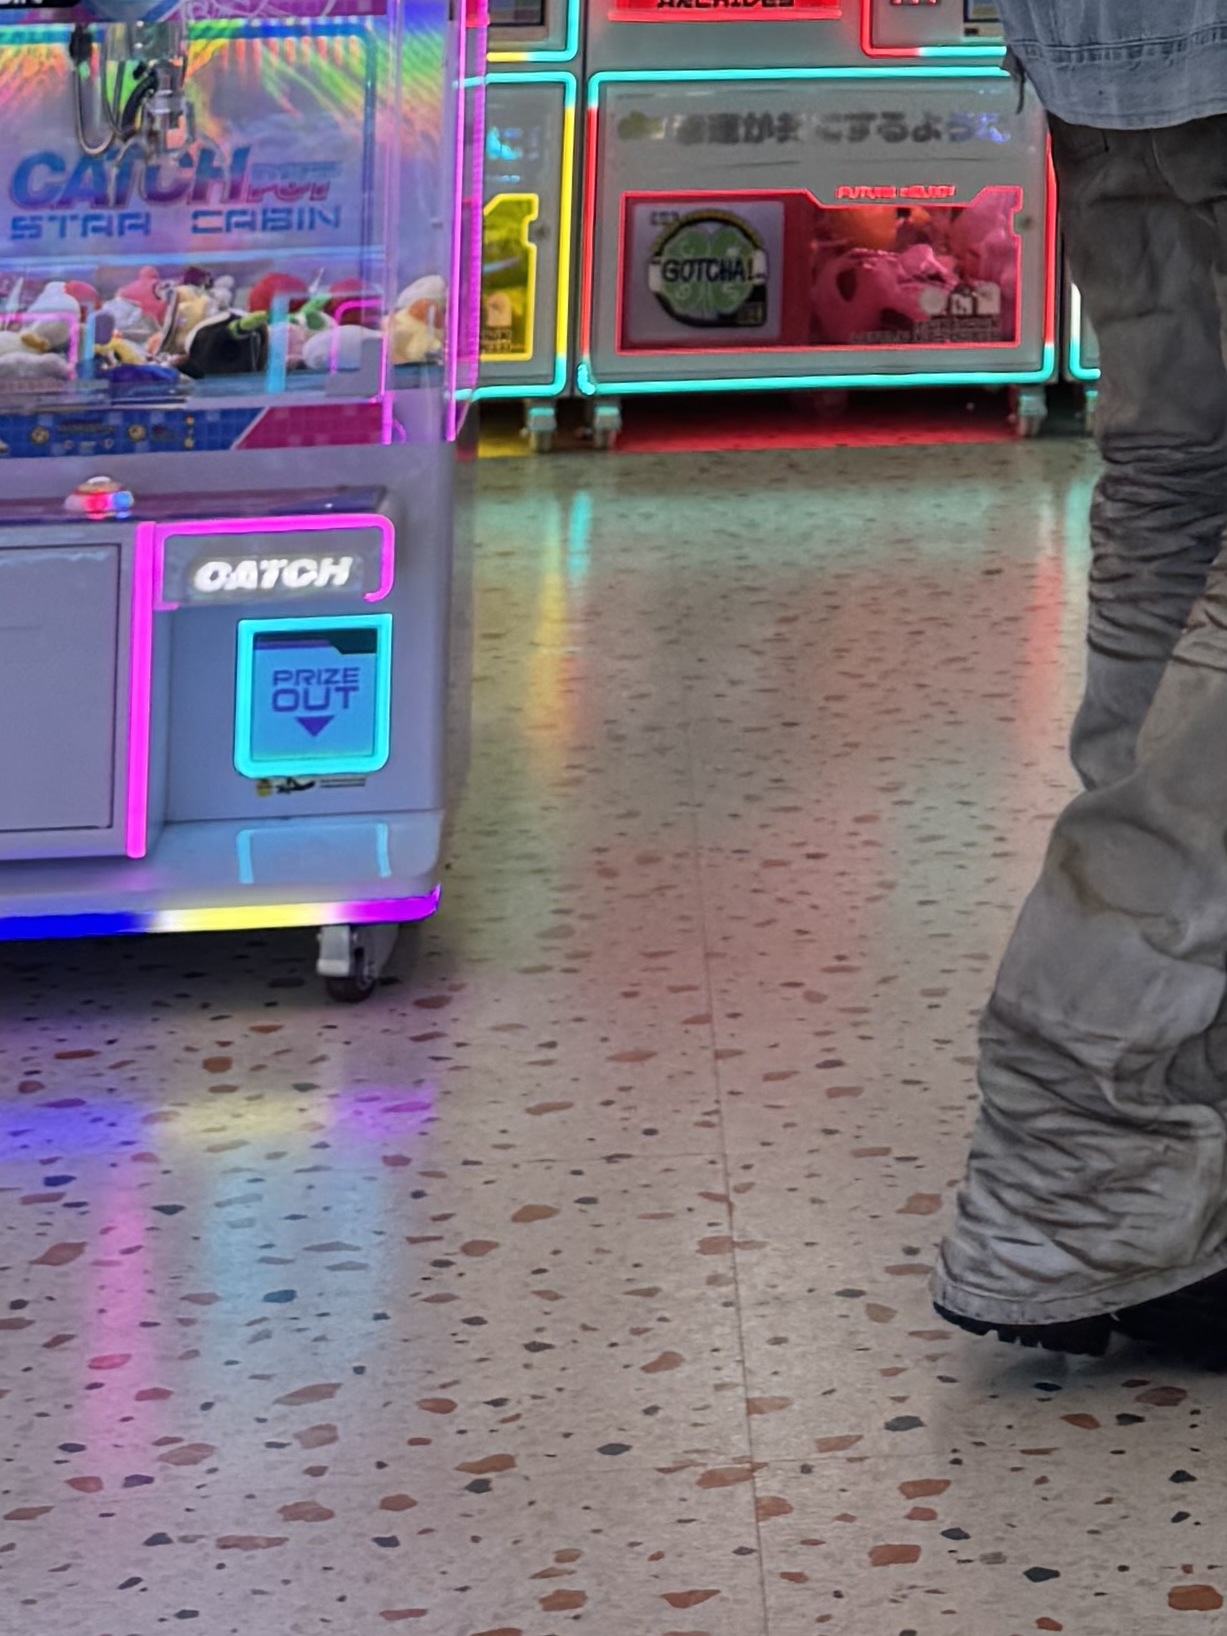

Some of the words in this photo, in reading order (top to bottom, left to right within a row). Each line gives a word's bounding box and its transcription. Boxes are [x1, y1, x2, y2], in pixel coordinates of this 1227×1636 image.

[8, 143, 250, 210] CATCH
[10, 212, 150, 241] STAR
[190, 205, 343, 235] CABIN
[272, 667, 360, 686] PRIZE
[271, 685, 360, 713] OUT
